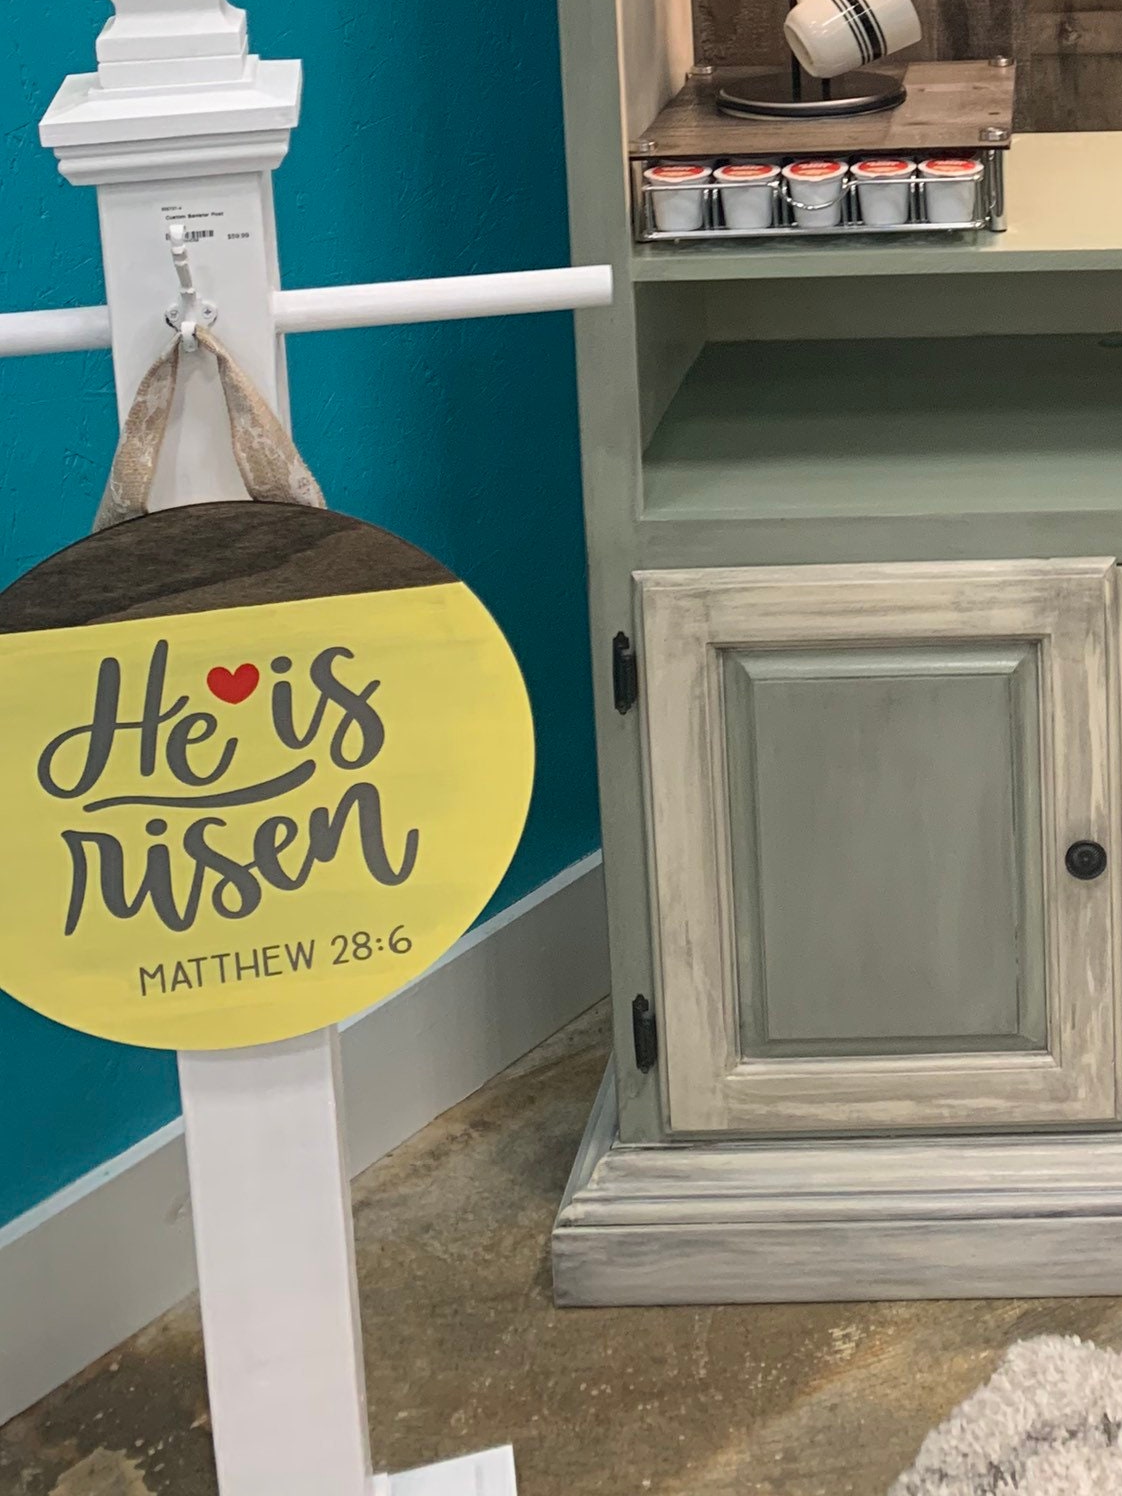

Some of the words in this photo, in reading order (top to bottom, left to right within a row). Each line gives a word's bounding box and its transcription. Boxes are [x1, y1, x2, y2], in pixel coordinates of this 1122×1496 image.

[37, 639, 239, 799] He
[270, 646, 386, 770] is
[61, 782, 419, 936] risen
[139, 940, 315, 996] MATTHEW
[330, 924, 413, 967] 28:6
